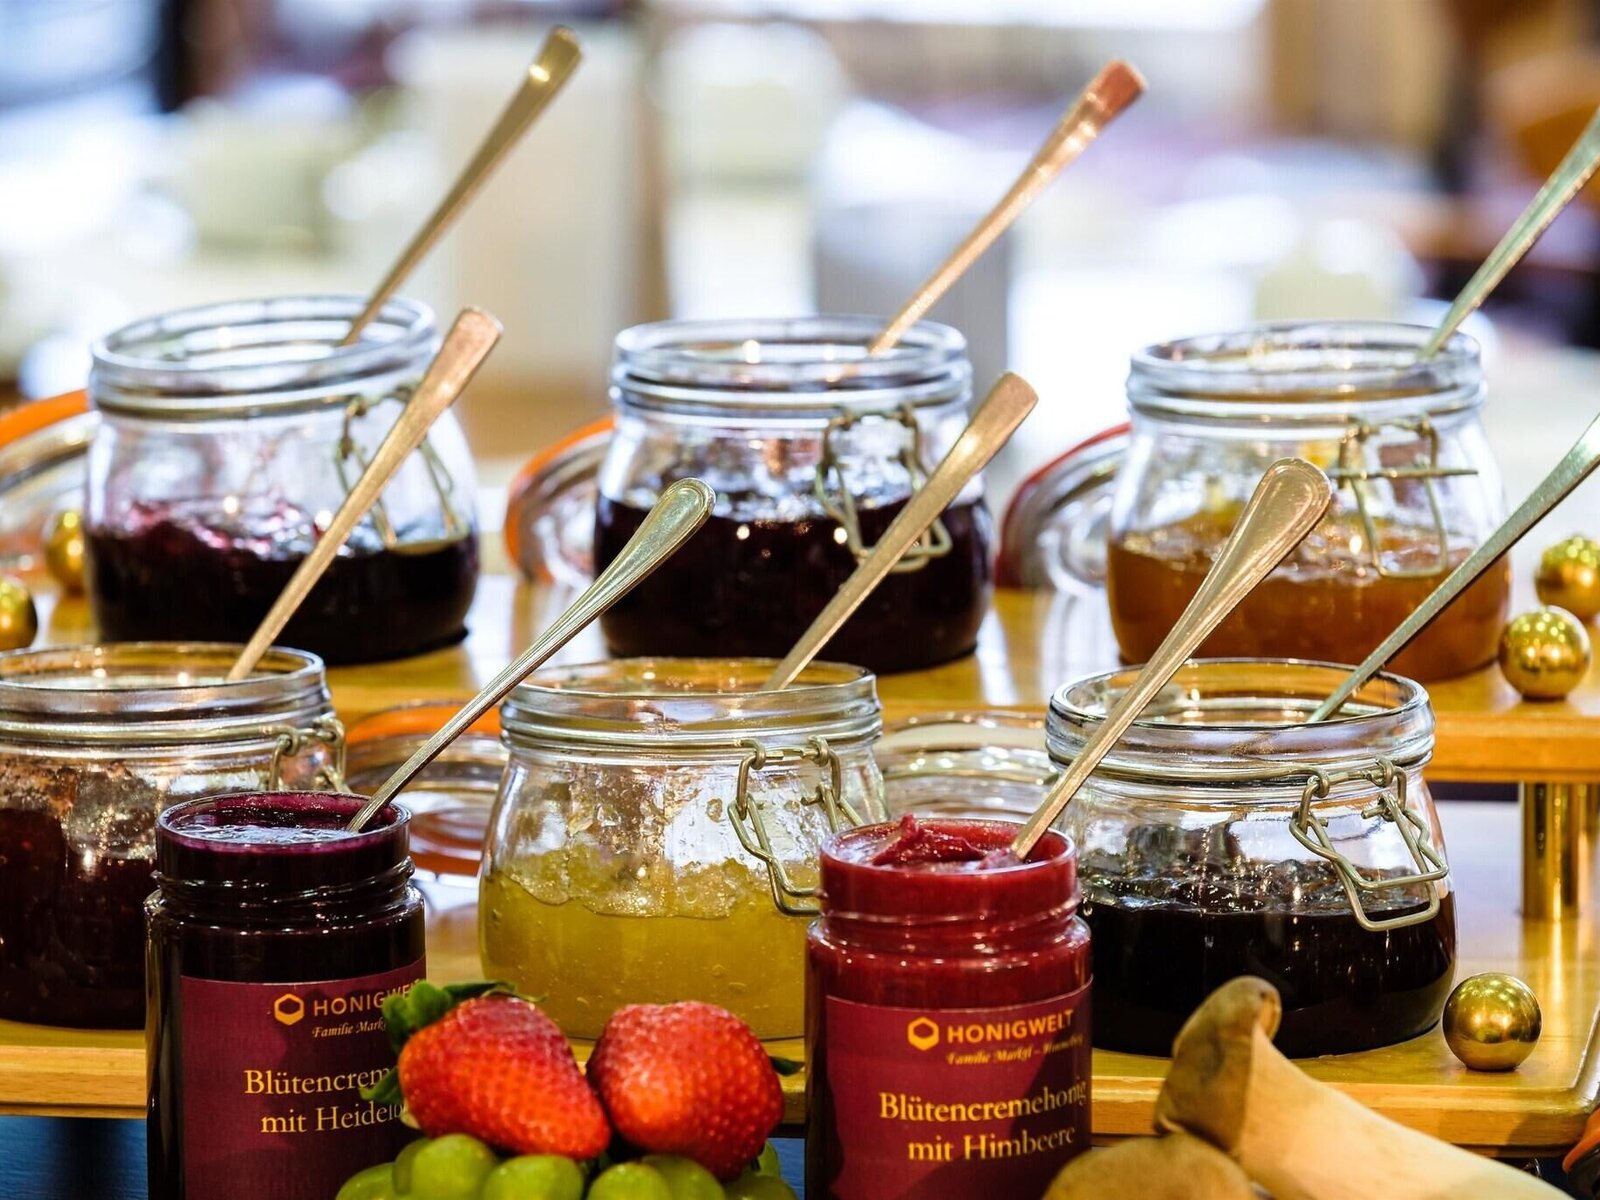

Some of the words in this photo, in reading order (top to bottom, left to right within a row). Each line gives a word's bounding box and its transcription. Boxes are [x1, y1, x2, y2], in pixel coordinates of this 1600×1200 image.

[312, 1022, 354, 1039] Familie
[356, 1016, 387, 1035] Mark
[947, 1009, 1075, 1044] HONIGWELT
[243, 1067, 391, 1095] Blütencrem
[879, 1076, 1087, 1122] Blütencremehonig
[260, 1108, 307, 1133] mit
[908, 1134, 954, 1162] mit
[963, 1126, 1076, 1160] Himbeere
